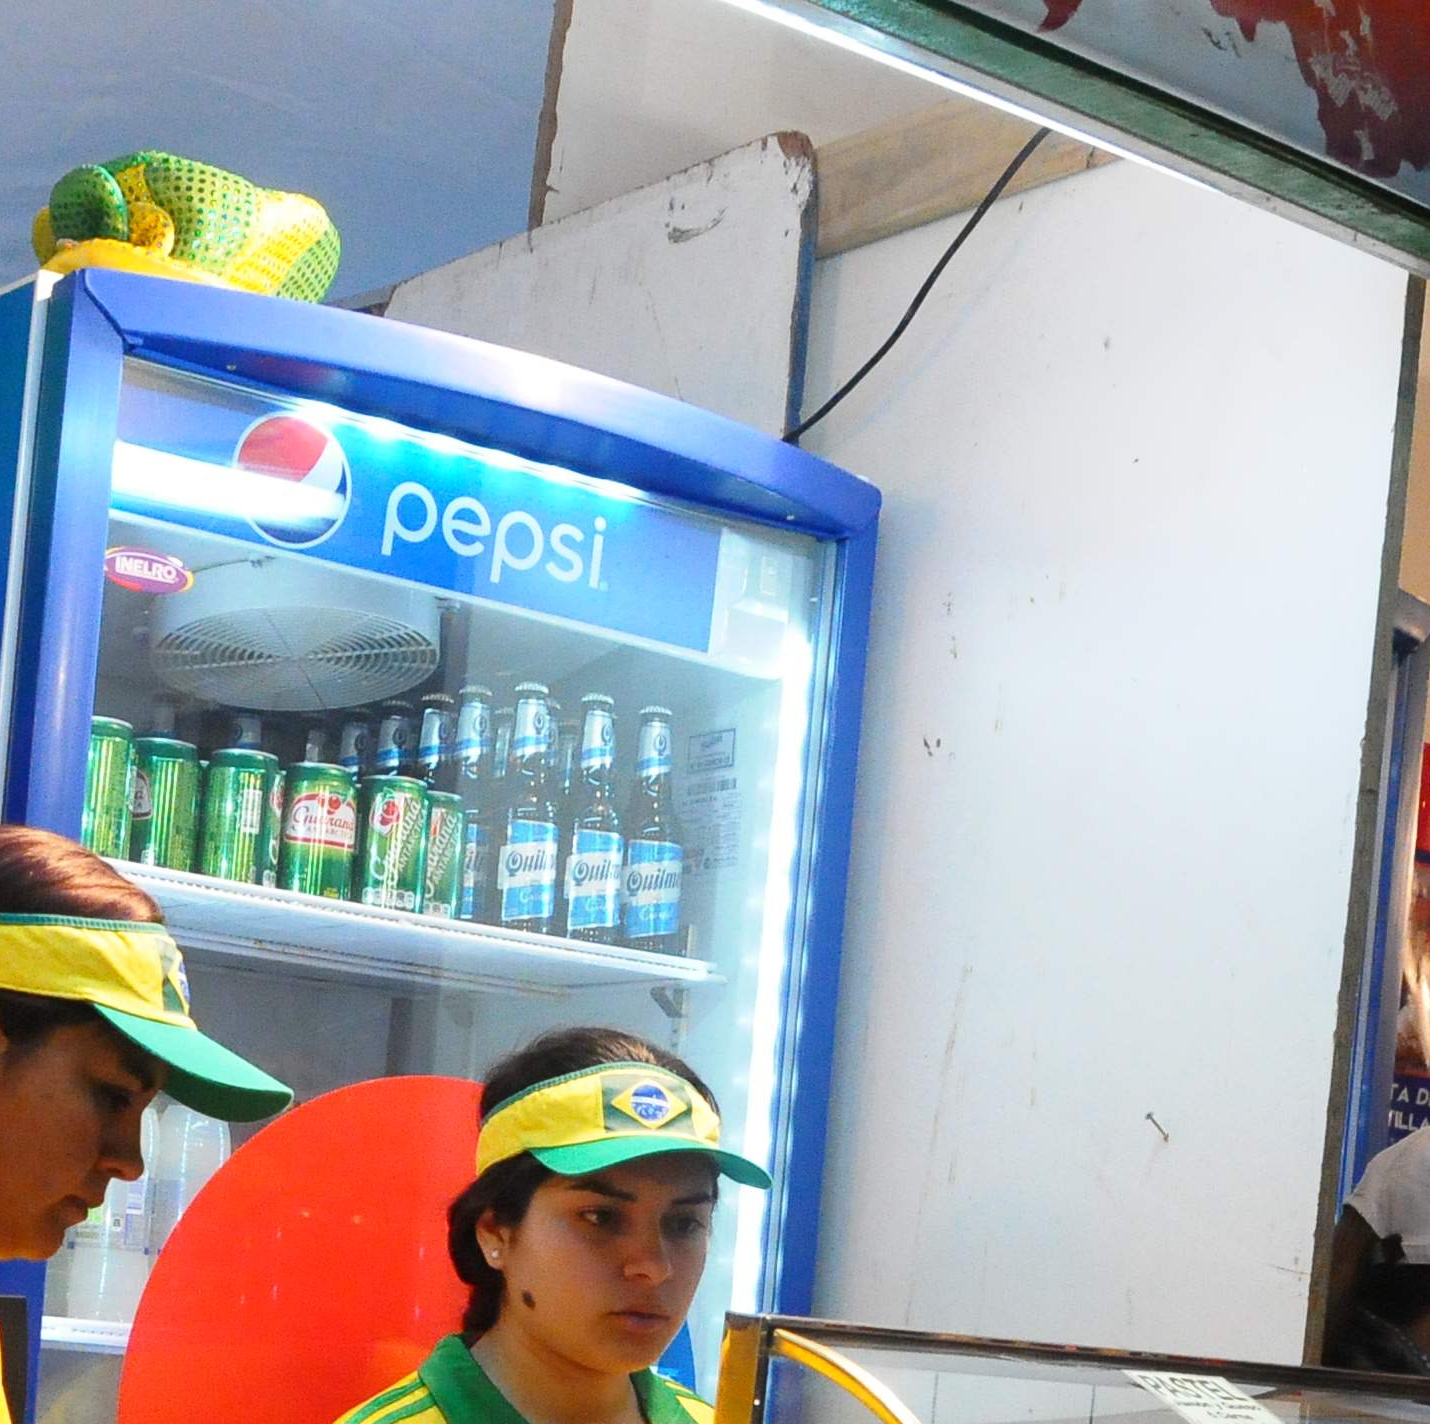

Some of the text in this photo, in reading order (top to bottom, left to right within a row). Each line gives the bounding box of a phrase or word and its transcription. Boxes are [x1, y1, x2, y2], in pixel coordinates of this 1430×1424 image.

[381, 481, 607, 589] pepsi
[115, 556, 177, 580] INELRO
[1138, 1374, 1249, 1402] PASTEL
